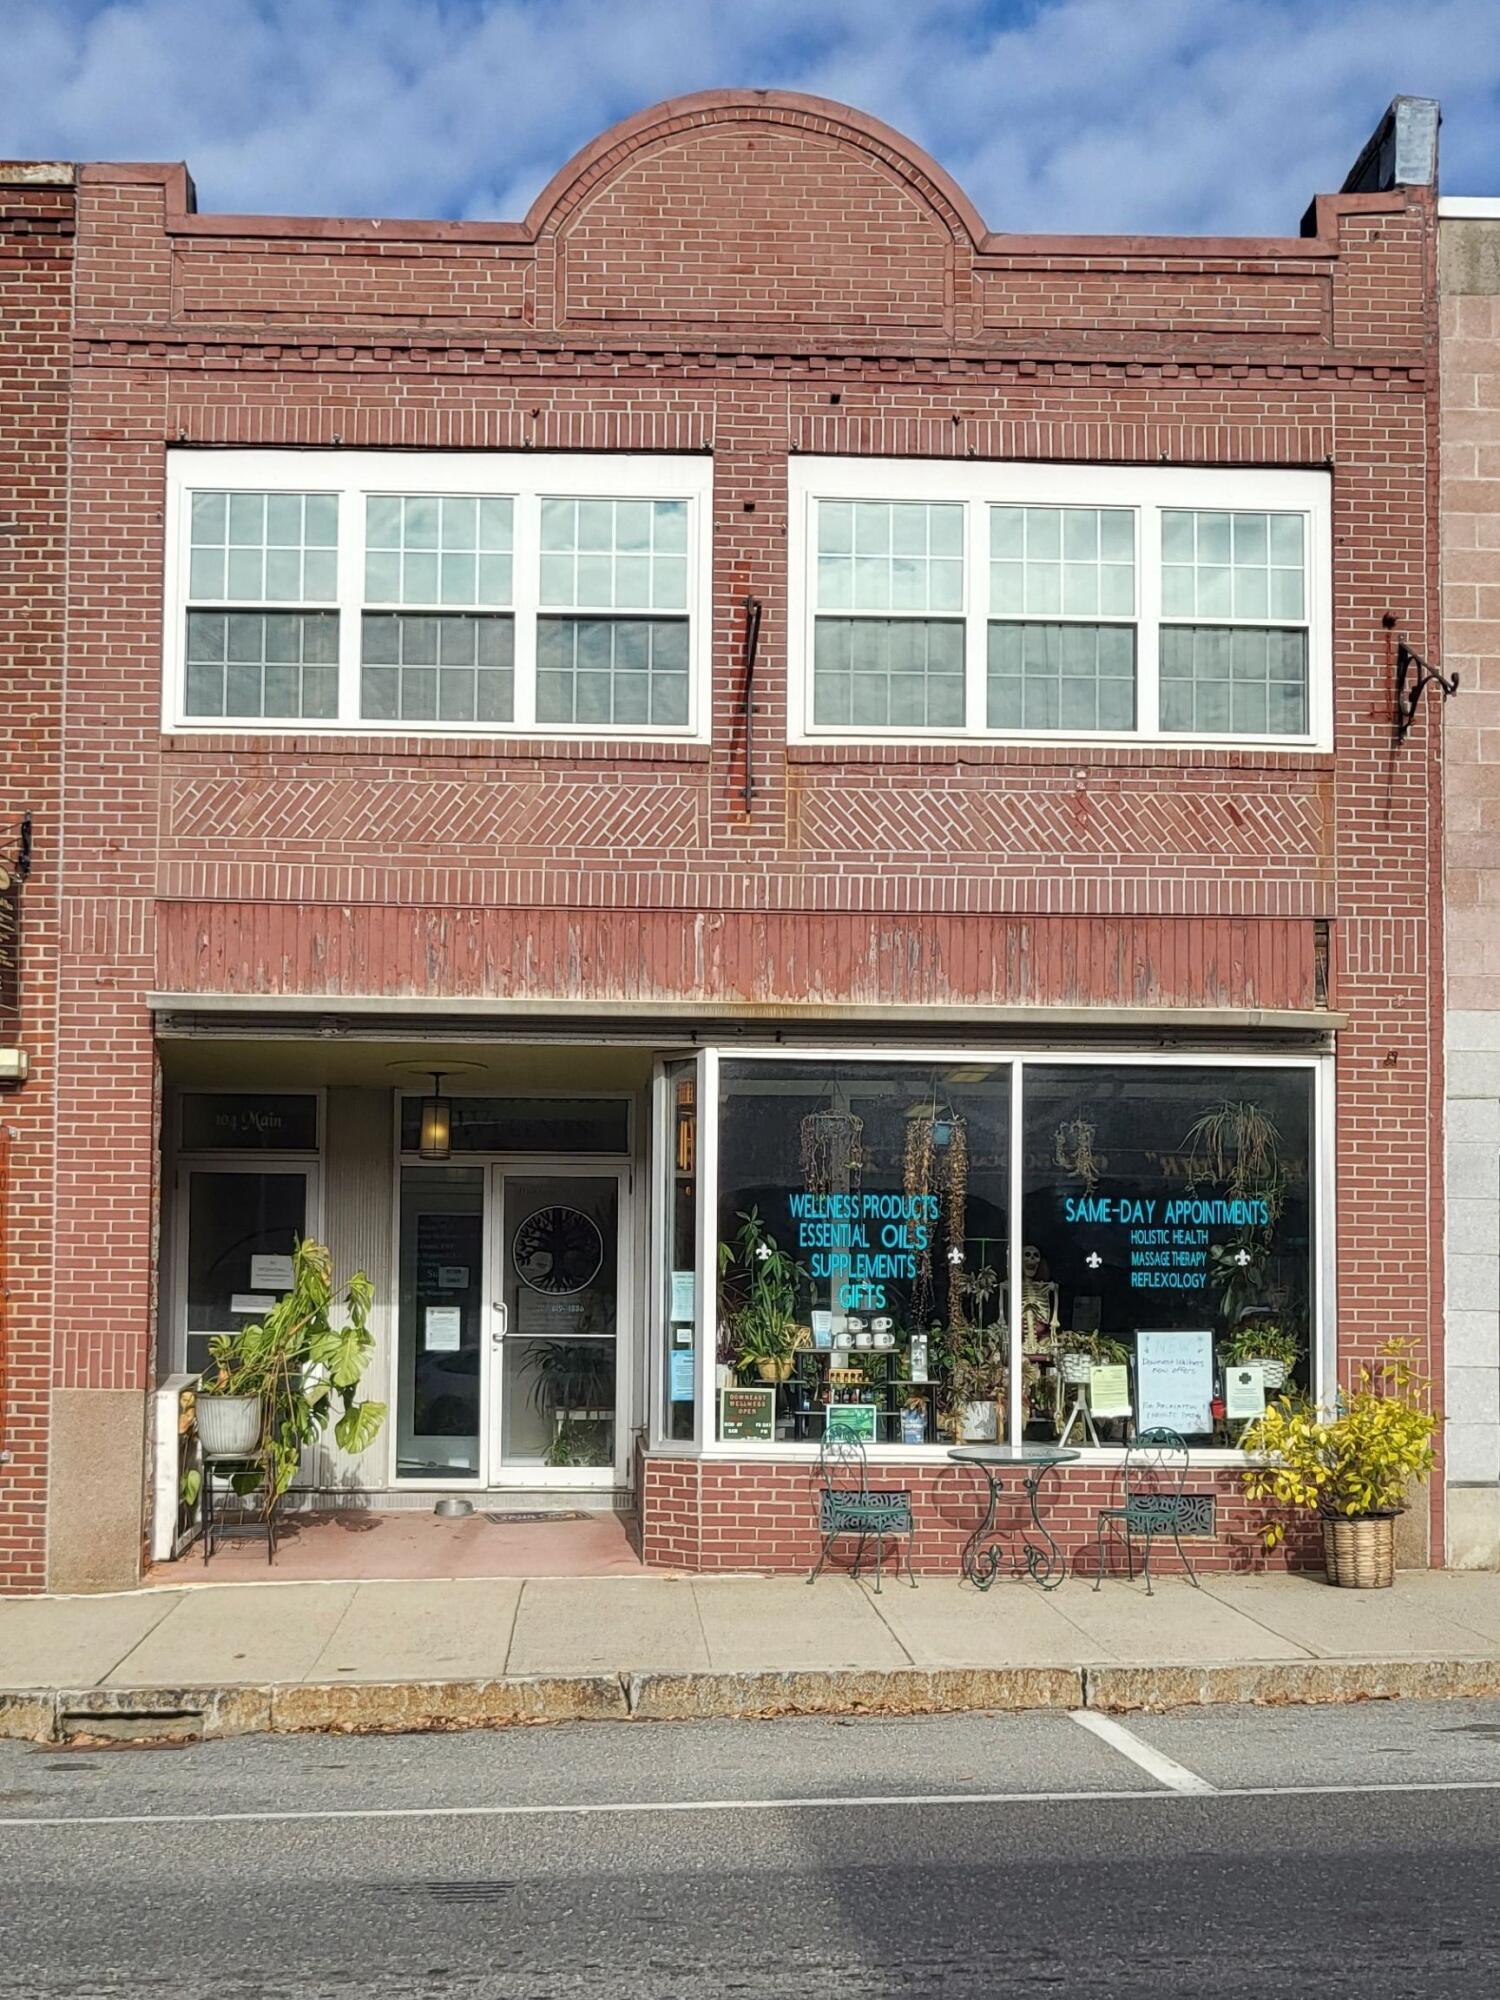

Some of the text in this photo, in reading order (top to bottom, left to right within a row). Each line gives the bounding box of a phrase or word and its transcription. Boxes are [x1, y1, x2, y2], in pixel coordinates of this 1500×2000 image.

[241, 1109, 282, 1132] Main
[789, 1193, 940, 1221] WELLNESS PRODUCTS
[1065, 1198, 1269, 1225] SAME-DAY APPOINTMENTS
[799, 1222, 928, 1250] ESSENTIAL OILS
[1131, 1229, 1209, 1245] HOLISTIC HEALTH
[810, 1252, 917, 1280] SUPPLEMENTS
[1131, 1251, 1207, 1267] MASSAGE THERAPY
[1131, 1272, 1208, 1289] REFLEXOLOGY
[839, 1283, 887, 1310] GIFTS
[738, 1408, 757, 1416] OPEN
